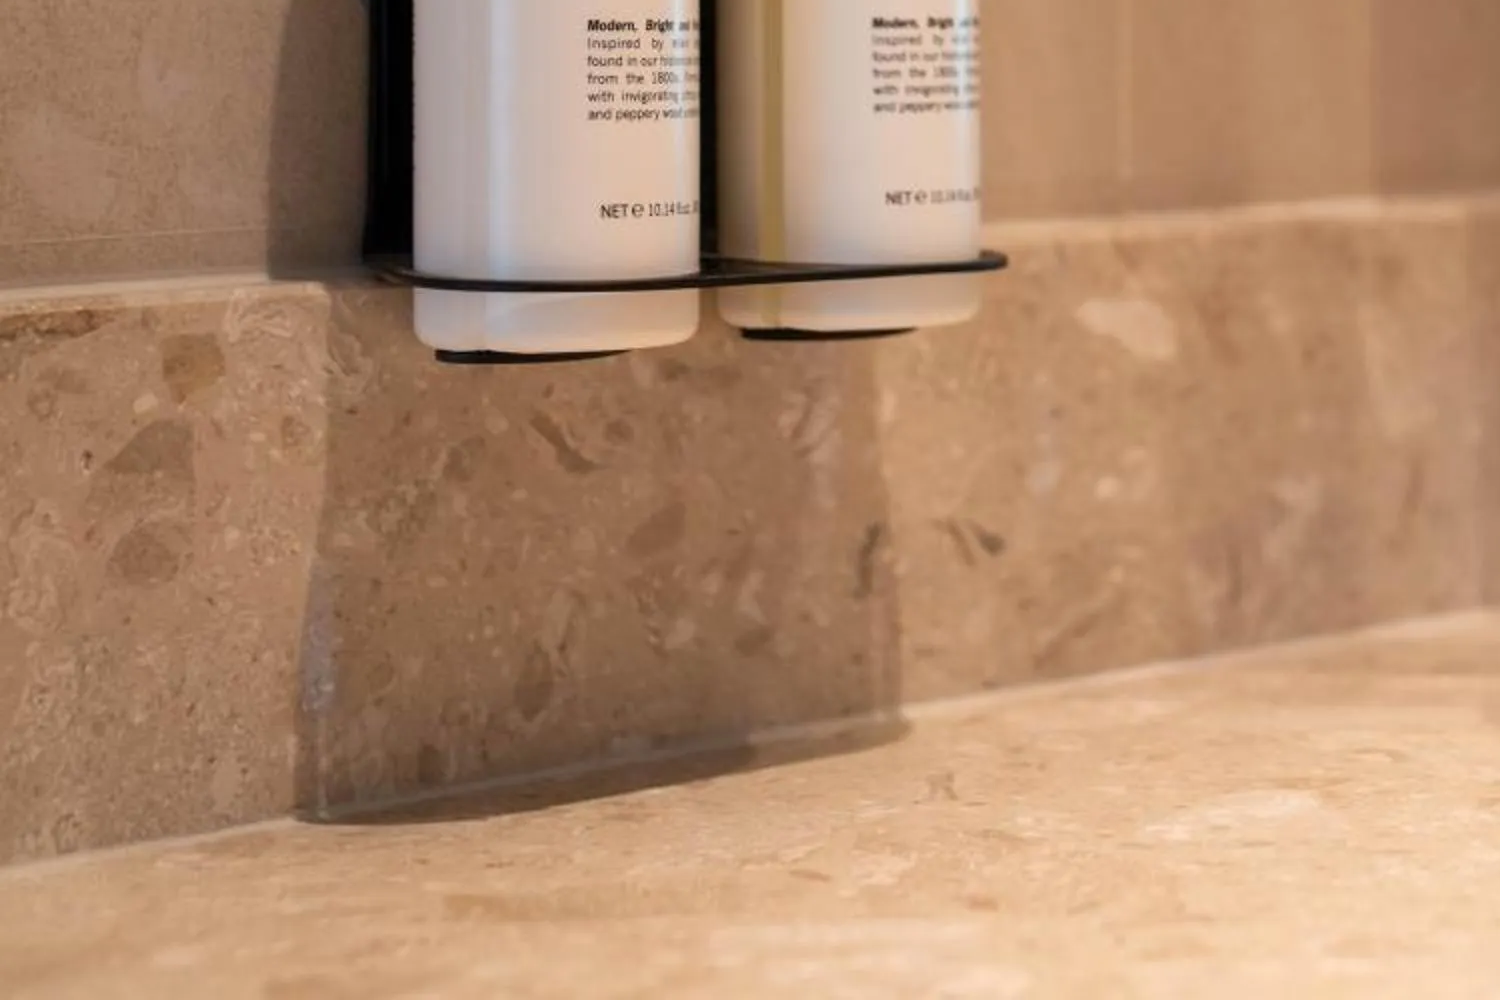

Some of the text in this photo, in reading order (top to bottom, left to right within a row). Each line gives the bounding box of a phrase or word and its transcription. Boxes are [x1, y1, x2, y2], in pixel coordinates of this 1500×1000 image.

[587, 38, 641, 51] Inspired
[652, 38, 663, 52] by
[587, 56, 623, 67] found
[640, 58, 657, 67] our
[587, 73, 619, 85] from
[626, 72, 645, 84] the
[587, 91, 615, 102] with
[588, 110, 612, 120] and
[616, 109, 659, 122] peppery
[600, 203, 628, 219] NET
